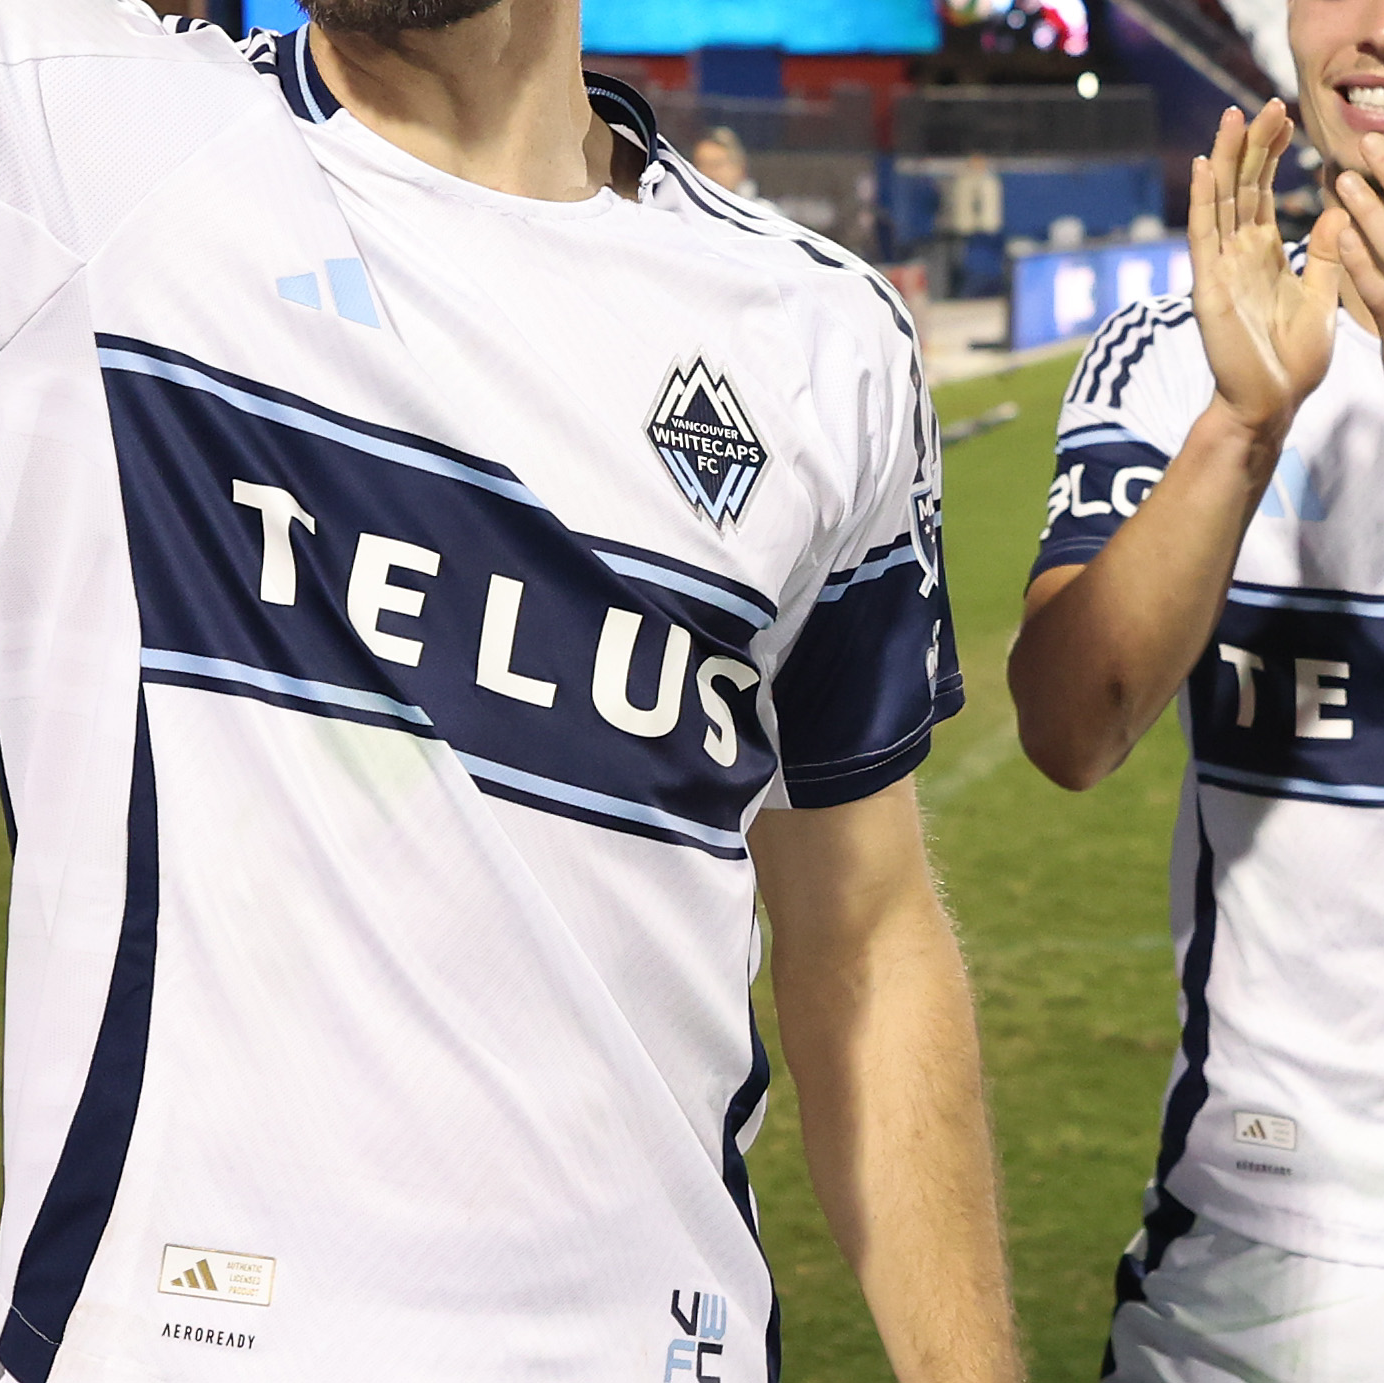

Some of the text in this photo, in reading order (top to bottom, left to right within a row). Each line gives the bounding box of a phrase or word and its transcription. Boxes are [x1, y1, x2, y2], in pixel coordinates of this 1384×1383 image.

[671, 418, 738, 440] VANCOUVER
[652, 426, 760, 463] WHITECAPS
[697, 456, 719, 474] FC
[232, 479, 759, 768] TELUS
[162, 1323, 256, 1350] AEROREADY
